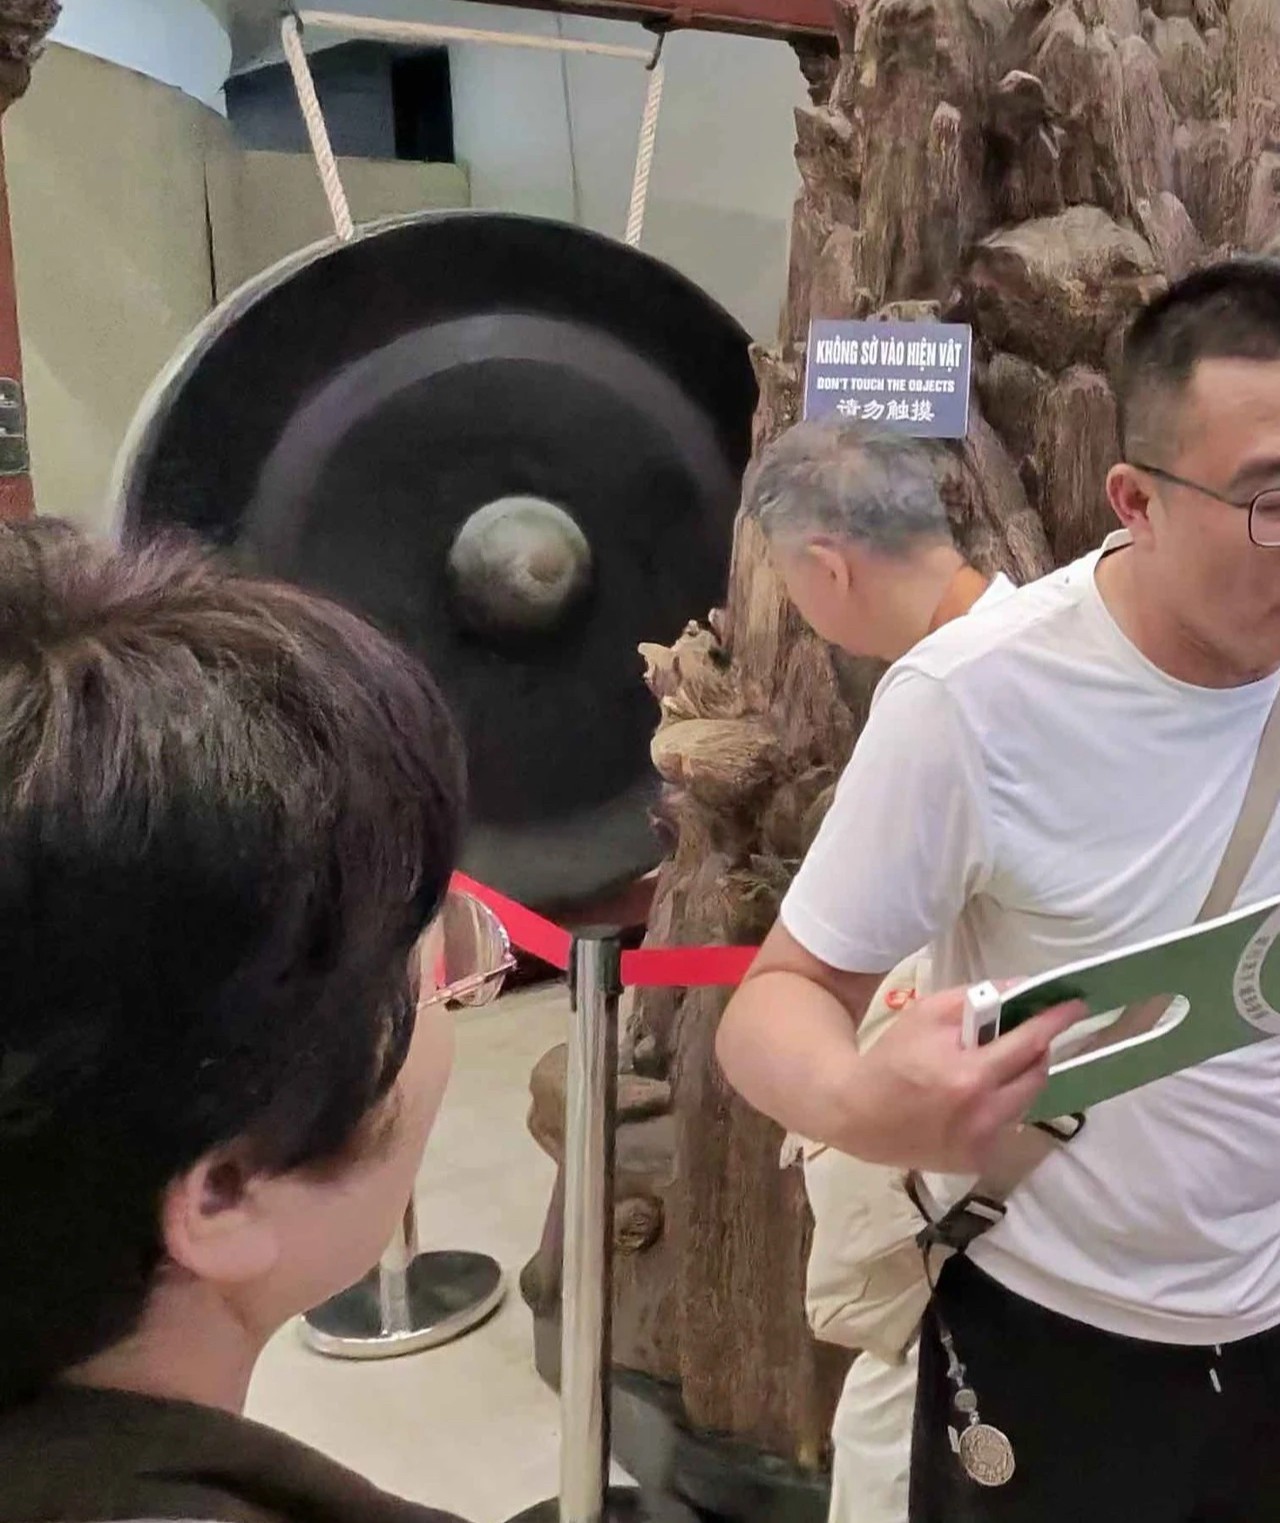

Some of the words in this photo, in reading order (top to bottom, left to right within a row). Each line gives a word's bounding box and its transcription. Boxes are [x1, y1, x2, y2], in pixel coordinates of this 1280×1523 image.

[816, 334, 858, 365] KHÔNG
[880, 336, 905, 366] VÀO
[906, 336, 936, 372] HIỆN
[939, 338, 962, 373] VẬT
[817, 376, 848, 391] DON'T
[851, 377, 884, 391] TOUCH
[887, 378, 906, 392] THE
[908, 379, 956, 393] OBJECTS
[836, 398, 936, 422] 请勿触摸
